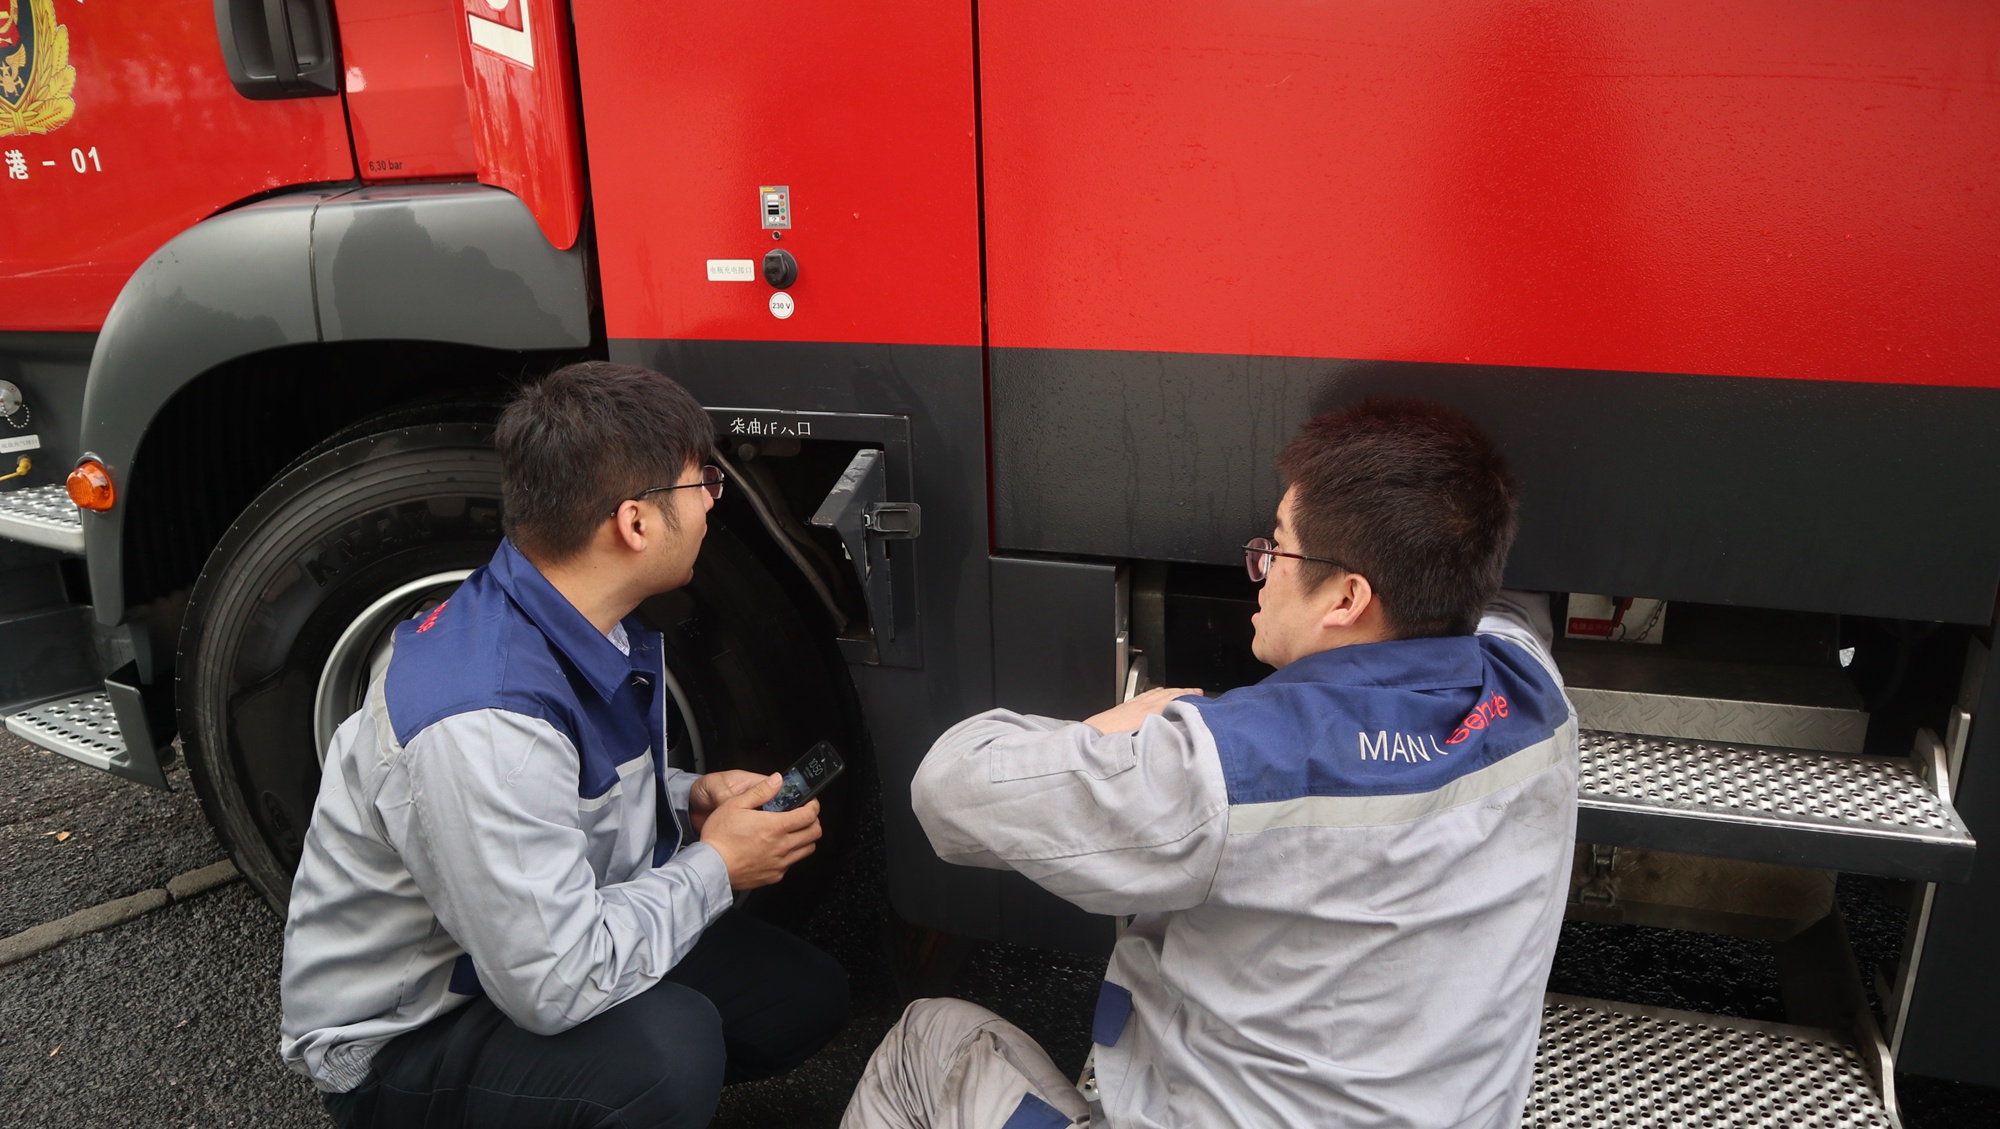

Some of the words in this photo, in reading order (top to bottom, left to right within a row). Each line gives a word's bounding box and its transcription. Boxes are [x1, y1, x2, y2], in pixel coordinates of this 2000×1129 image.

[4, 149, 29, 180] 港
[70, 146, 102, 174] 01
[369, 160, 387, 173] 6,30
[388, 159, 403, 170] bar
[772, 302, 785, 310] 230
[1358, 729, 1432, 763] MAN
